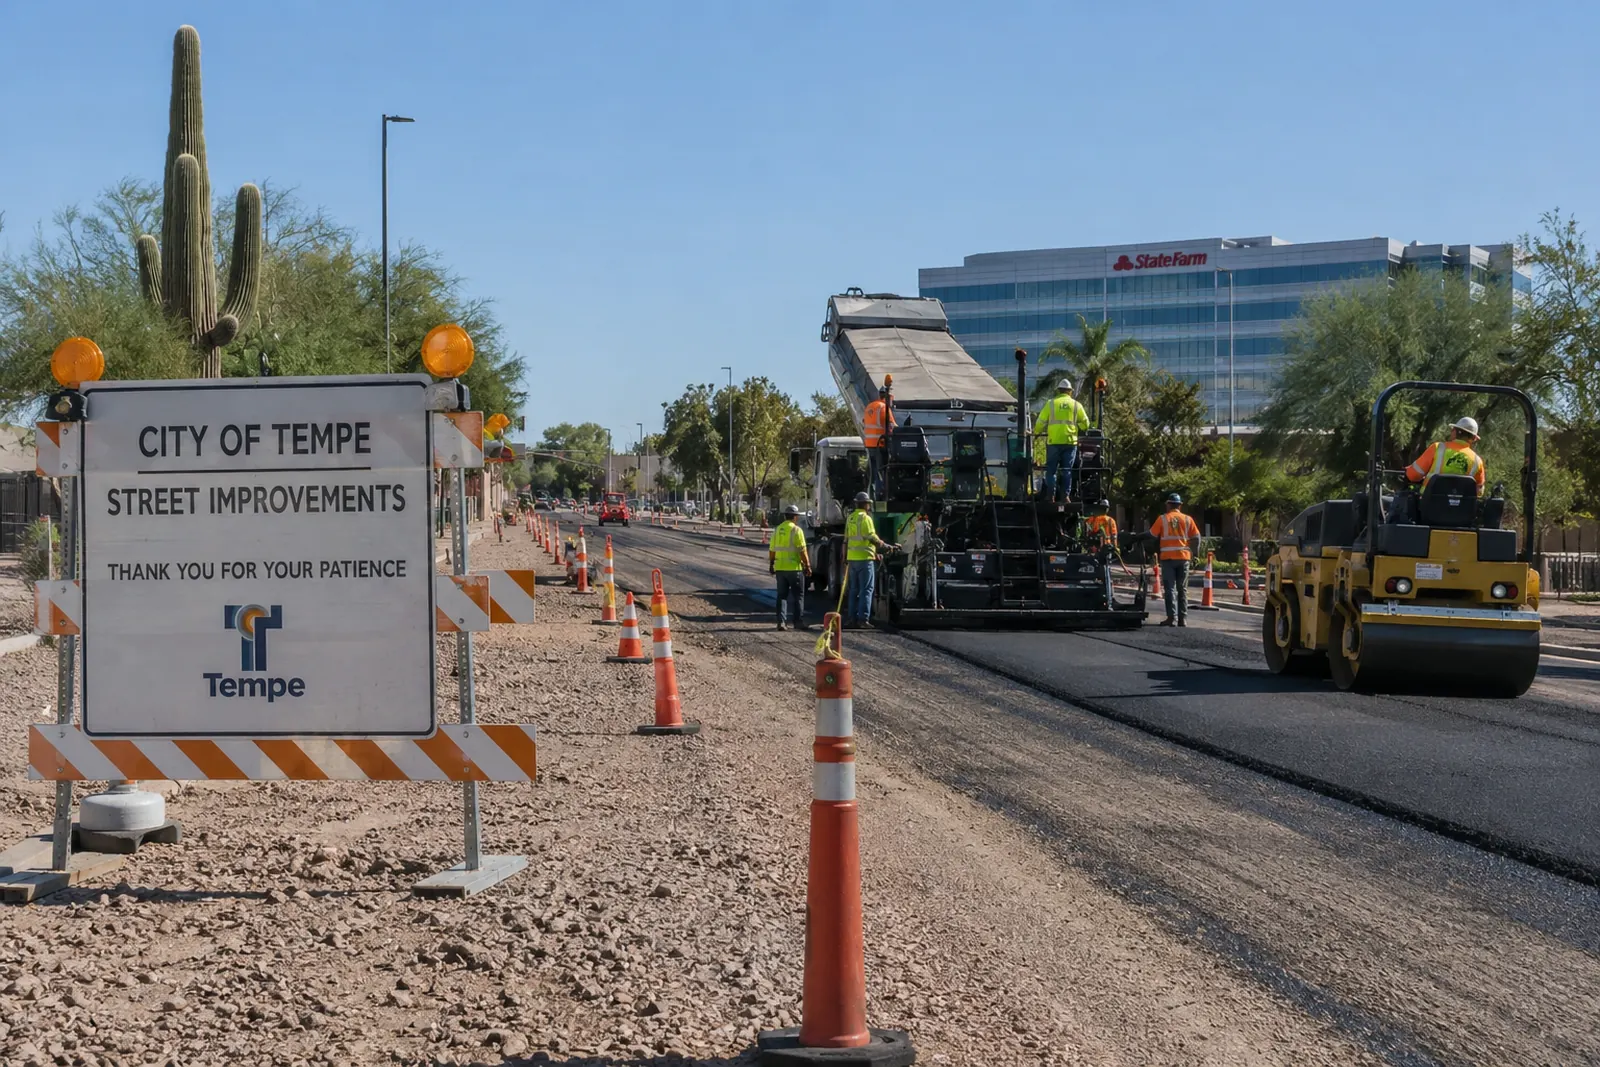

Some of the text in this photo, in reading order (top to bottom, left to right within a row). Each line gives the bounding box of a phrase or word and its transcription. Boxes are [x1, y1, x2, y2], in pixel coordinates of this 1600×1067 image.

[138, 421, 372, 458] CITY OF TEMPE
[107, 484, 406, 517] STREET IMPROVEMENTS
[107, 559, 407, 581] THANK YOU FOR YOUR PATIENCE
[202, 672, 306, 703] Tempe
